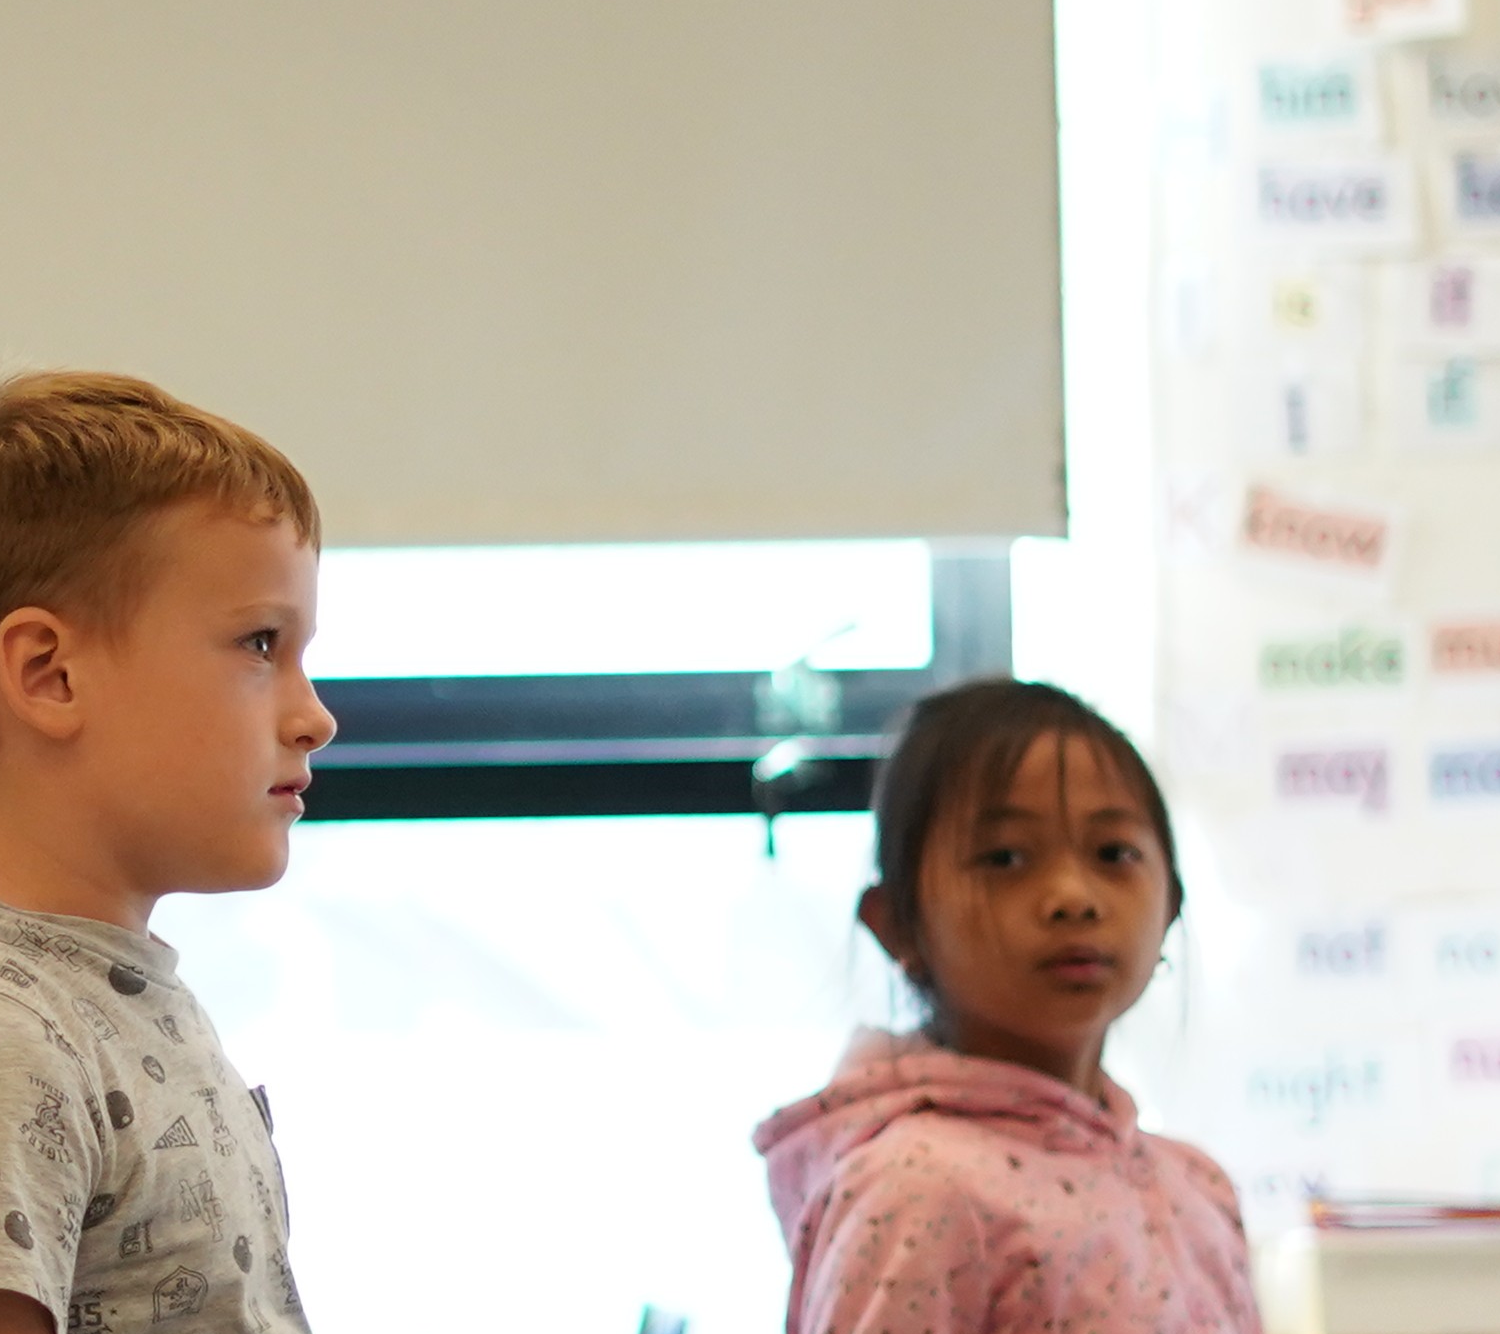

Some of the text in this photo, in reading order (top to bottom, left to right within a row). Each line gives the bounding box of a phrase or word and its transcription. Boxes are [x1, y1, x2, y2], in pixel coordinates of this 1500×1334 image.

[1258, 165, 1388, 223] have
[1242, 484, 1388, 569] know
[1258, 624, 1405, 692] make
[1275, 747, 1389, 814] may
[1296, 923, 1388, 977] not
[19, 1121, 74, 1165] TIGERS
